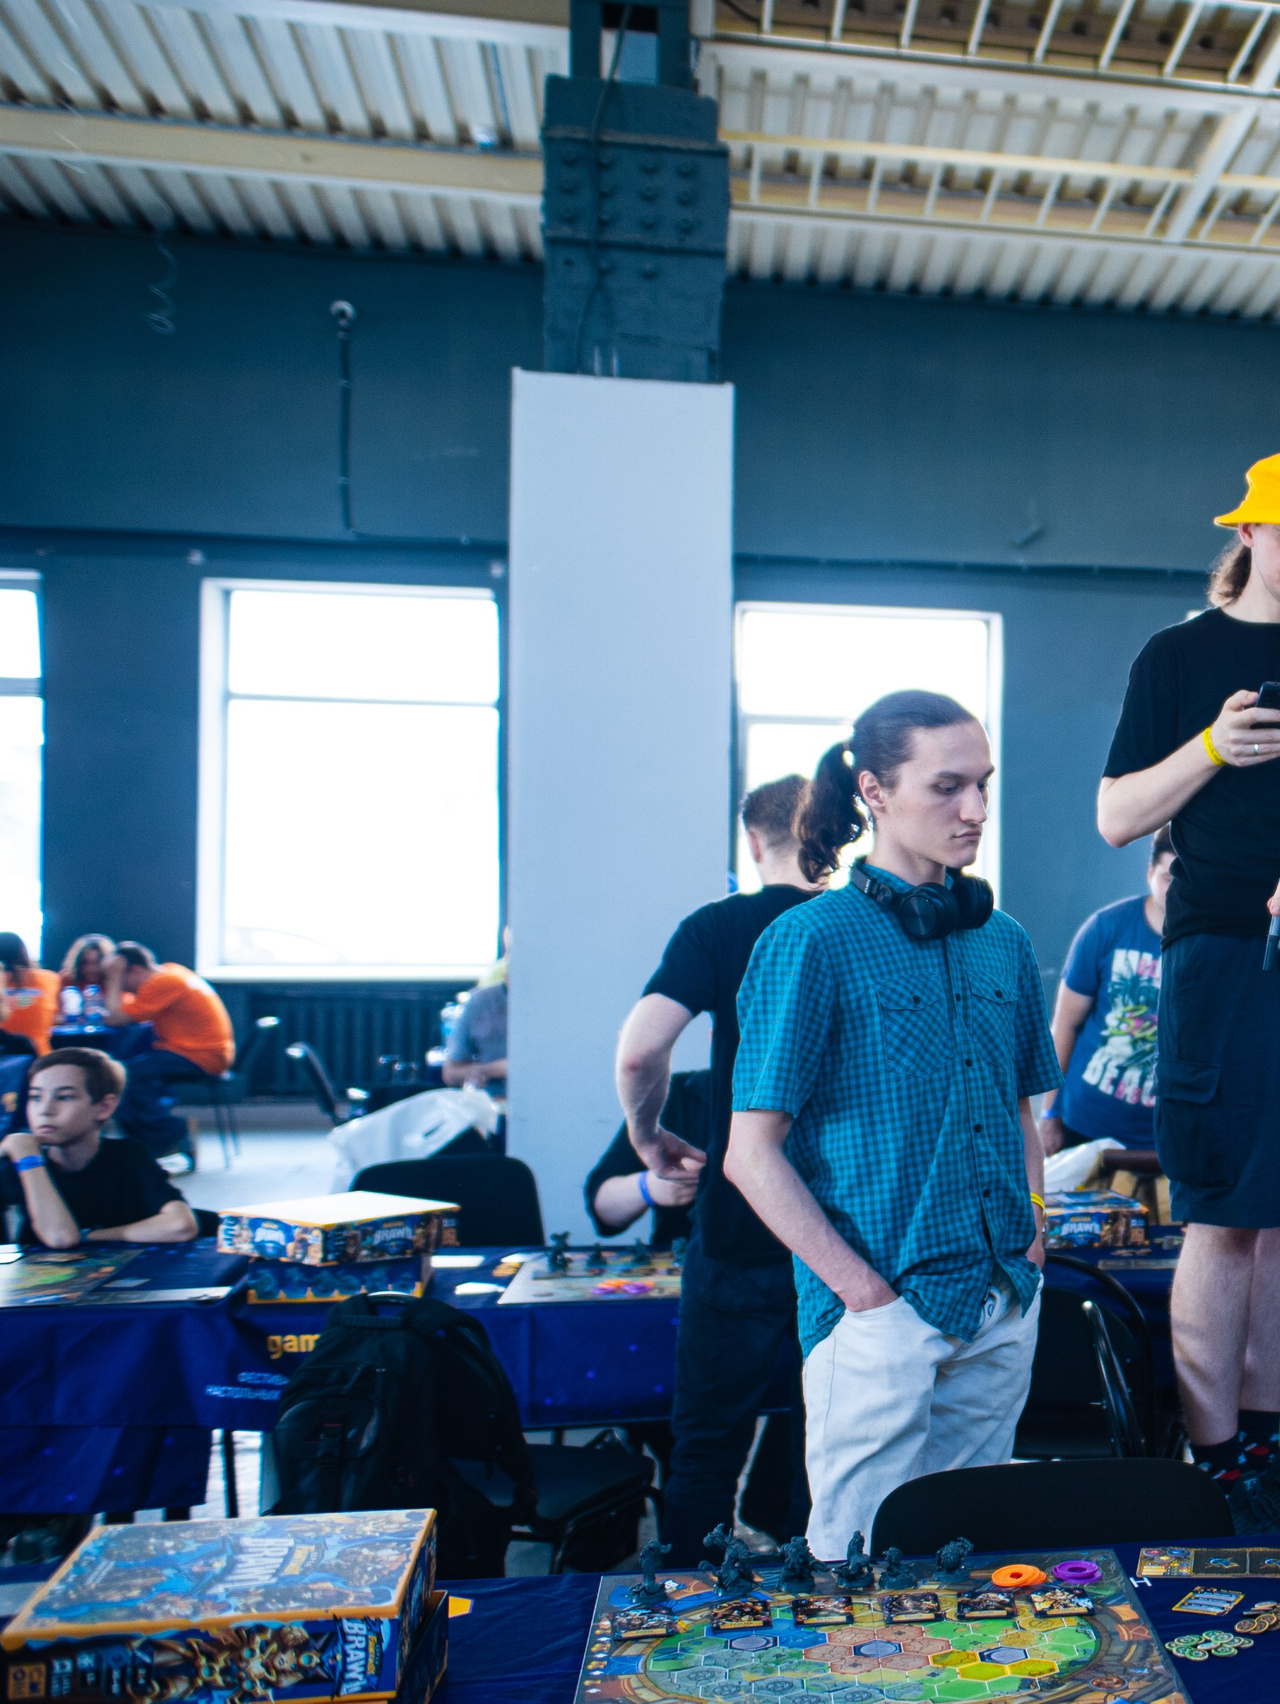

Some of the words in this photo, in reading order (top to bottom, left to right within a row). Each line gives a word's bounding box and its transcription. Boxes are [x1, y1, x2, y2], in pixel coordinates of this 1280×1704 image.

[267, 1334, 321, 1359] gam
[204, 1537, 295, 1595] BRAWL
[340, 1617, 367, 1696] BRAWL
